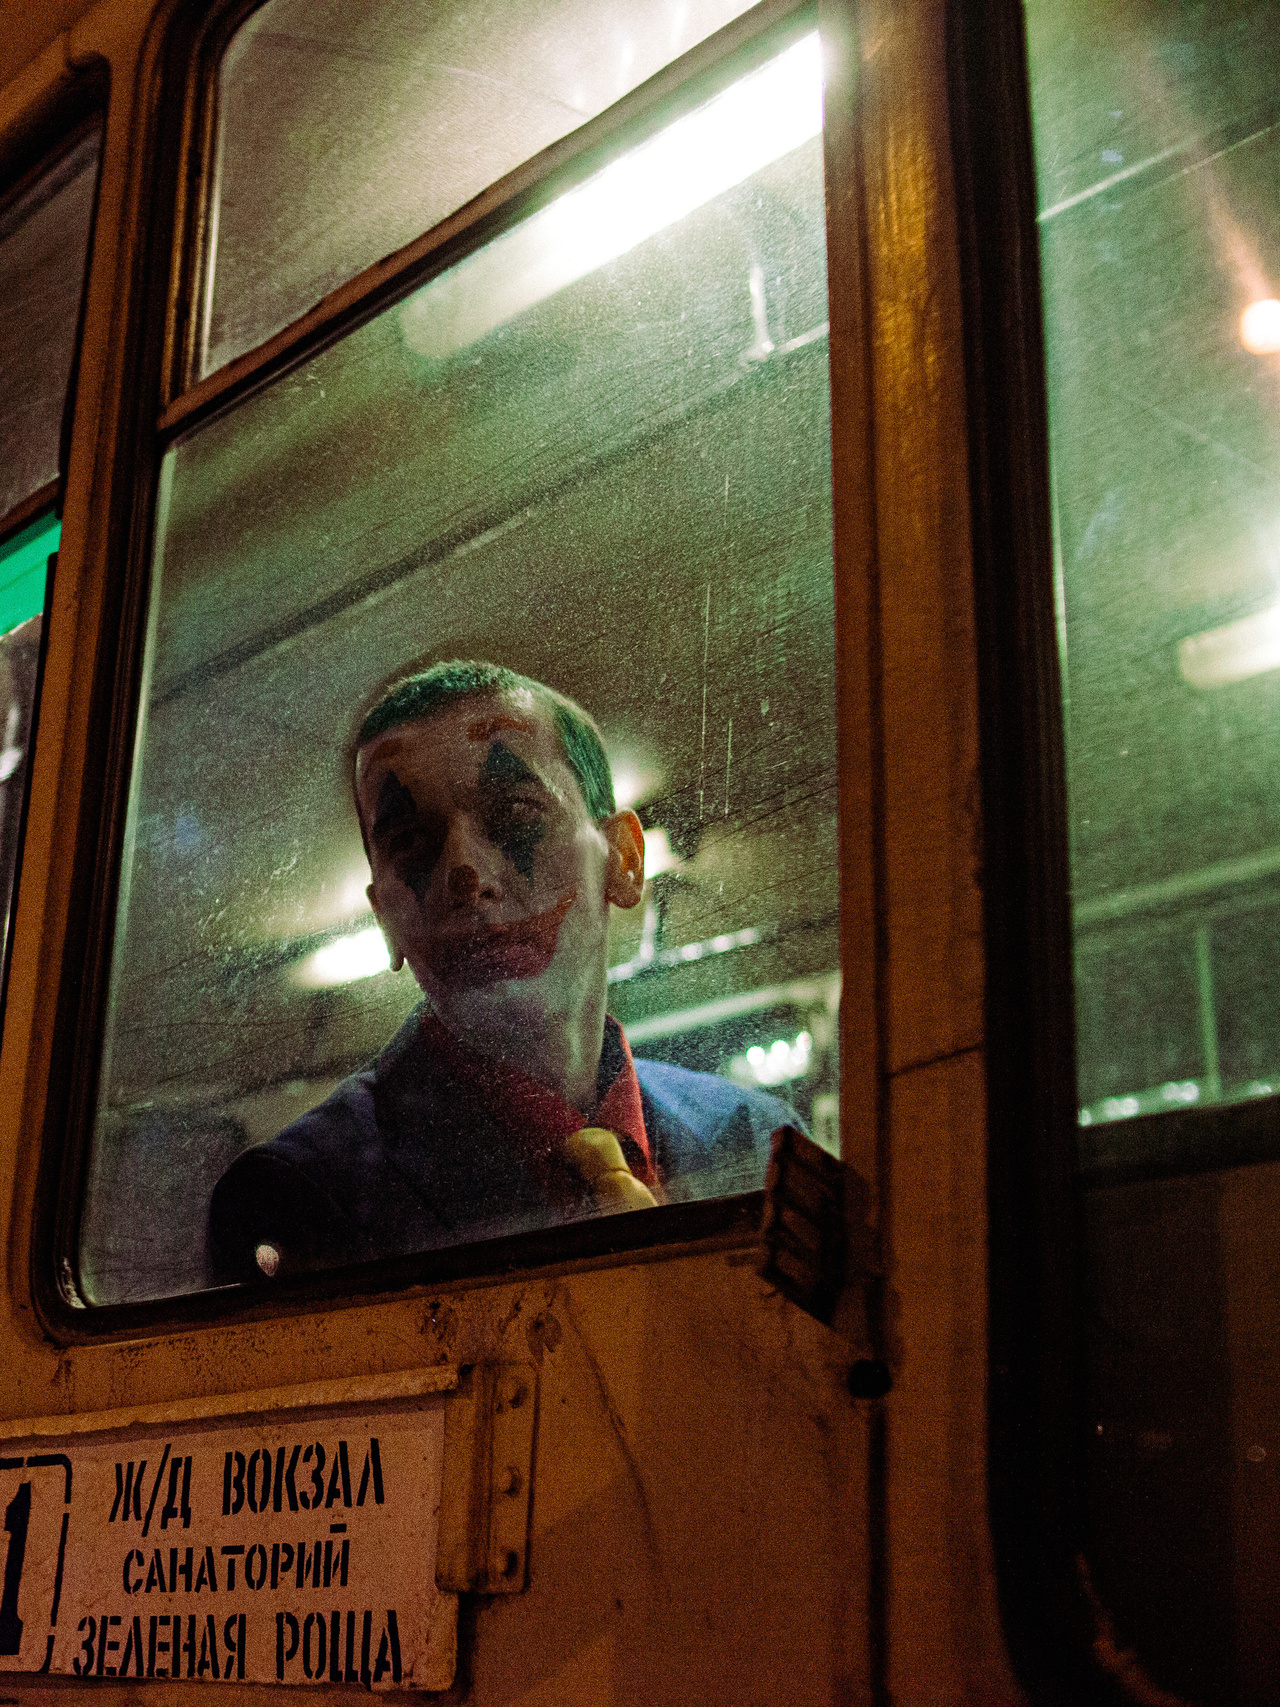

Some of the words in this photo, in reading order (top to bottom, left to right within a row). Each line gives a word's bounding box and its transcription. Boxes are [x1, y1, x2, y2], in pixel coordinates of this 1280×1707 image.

[108, 1443, 193, 1538] Ж/Д
[221, 1437, 386, 1517] ВОКЗАЛ
[122, 1523, 351, 1595] САНАТОРИЙ
[73, 1613, 247, 1680] ЗЕЛЕНАЯ
[275, 1610, 402, 1692] РОЩА
